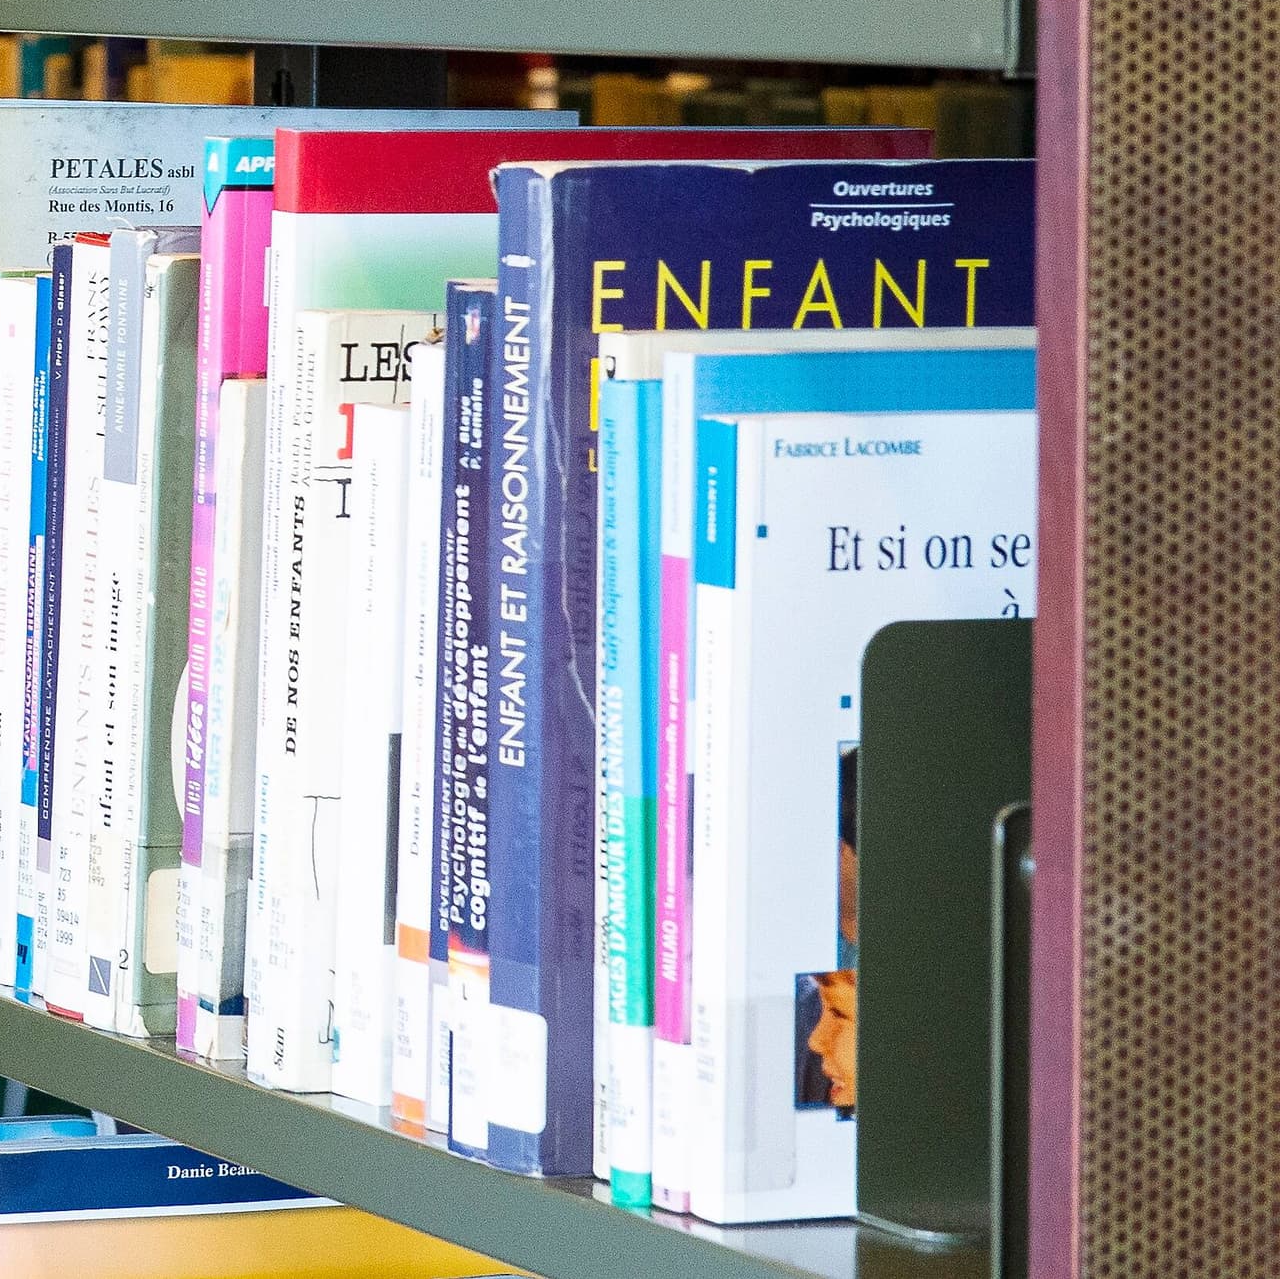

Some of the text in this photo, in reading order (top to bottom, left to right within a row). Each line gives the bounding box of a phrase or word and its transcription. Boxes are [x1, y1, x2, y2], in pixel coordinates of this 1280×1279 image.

[48, 185, 170, 197] (Association Sans But Lucratif)
[48, 199, 174, 214] Rue des Montis, 16
[50, 158, 195, 178] PETALES asbl
[831, 180, 934, 197] Ouvertures
[809, 210, 951, 232] Psychologiques
[57, 272, 66, 311] Glaser
[86, 270, 98, 360] FRANK
[590, 257, 990, 335] ENFANT
[55, 337, 64, 367] Prior
[114, 278, 128, 433] ANNE-MARIE FONTAINE
[339, 341, 412, 382] LES
[458, 395, 472, 469] A. Blaye
[470, 377, 483, 470] P. Lemaire
[773, 437, 923, 458] FABRICE LACOMBE
[498, 296, 533, 770] ENFANT ET RAISONNEMENT
[826, 524, 1032, 571] Et si on se
[23, 545, 37, 757] L'AUTONOMIE HUMAINE
[71, 475, 100, 818] ENFANTS REBELLES
[284, 495, 306, 757] DE NOS ENFANTS
[99, 572, 122, 829] nfant et son image
[185, 566, 208, 816] Des idées plein la tête
[438, 527, 455, 932] DÉVELOPPEMENT COGNITIF ET COMMUNICATIF
[449, 484, 472, 925] Psychologie du développement
[603, 685, 626, 788] ENFANTS
[468, 644, 491, 932] cognitif de l'enfant
[607, 791, 626, 838] DES
[59, 866, 72, 883] 723
[608, 840, 627, 953] D'AMOUR
[56, 929, 74, 946] 1999
